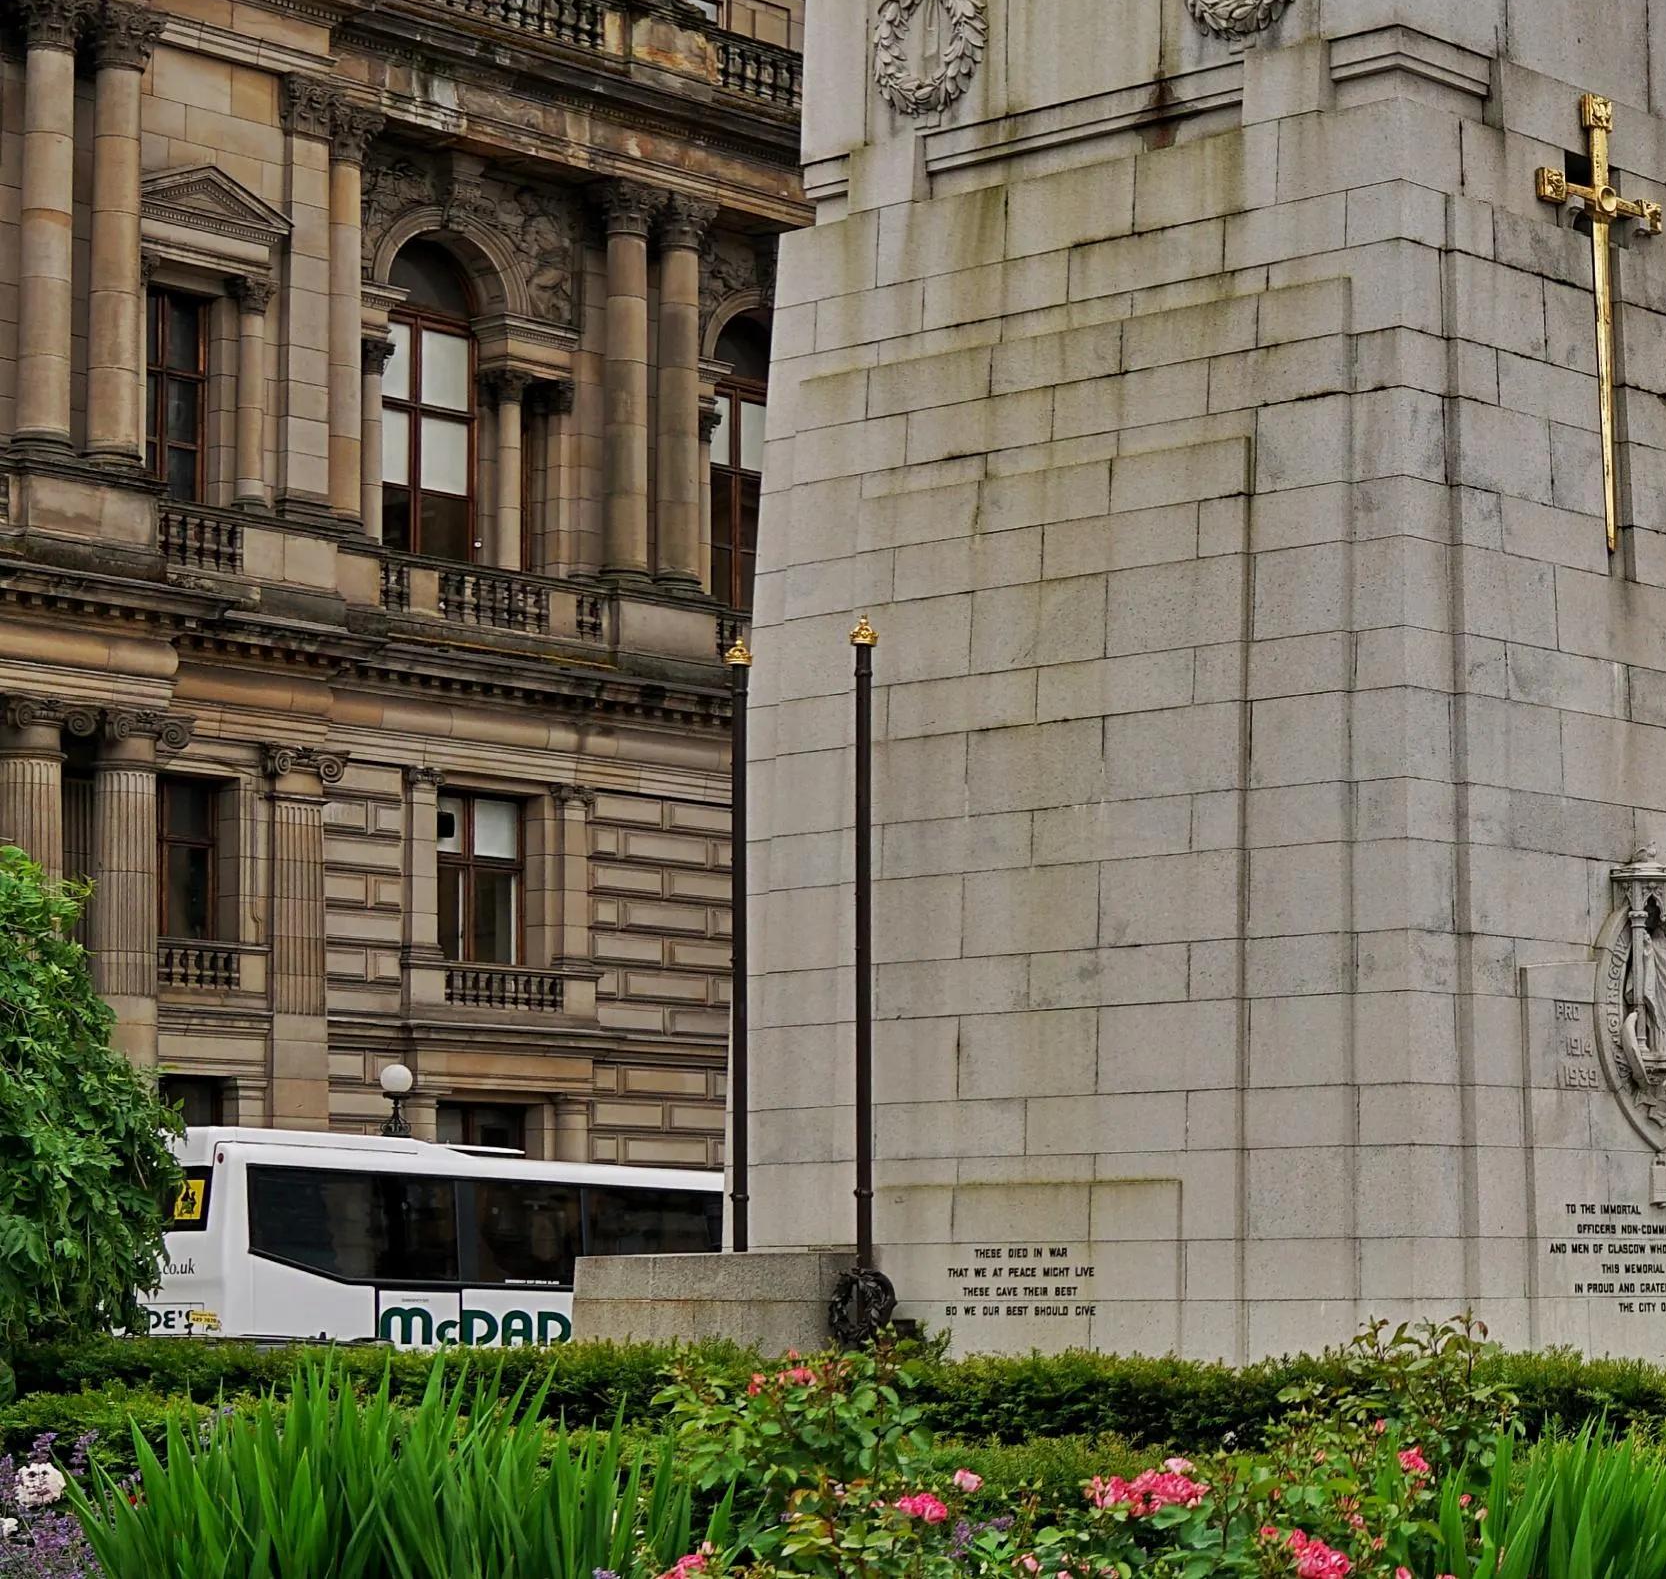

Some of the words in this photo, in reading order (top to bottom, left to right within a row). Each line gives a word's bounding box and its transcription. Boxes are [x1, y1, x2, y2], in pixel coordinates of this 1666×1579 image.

[1565, 1203, 1577, 1215] TO
[1580, 1203, 1596, 1215] THE
[1600, 1203, 1642, 1216] IMMORTAL
[1576, 1223, 1617, 1235] OFFICERS
[974, 1248, 1002, 1259] THESE
[1007, 1247, 1029, 1259] DIED
[1033, 1247, 1043, 1259] IN
[1048, 1247, 1068, 1258] WAR
[1549, 1243, 1567, 1255] AND
[1571, 1243, 1590, 1255] MEN
[1592, 1243, 1604, 1255] OF
[1607, 1243, 1647, 1255] GLASGOW
[947, 1267, 969, 1278] THAT
[973, 1267, 987, 1278] WE
[991, 1267, 1004, 1278] AT
[1007, 1266, 1037, 1278] PEACE
[1042, 1266, 1070, 1278] MIGHT
[1074, 1266, 1095, 1278] LIVE
[1601, 1263, 1620, 1274] THIS
[1624, 1263, 1665, 1275] MEMORIAL
[962, 1286, 990, 1297] THESE
[995, 1286, 1018, 1297] GAVE
[1022, 1286, 1049, 1297] THEIR
[1054, 1286, 1078, 1297] BEST
[1574, 1282, 1584, 1294] IN
[1586, 1282, 1615, 1294] PROUD
[1618, 1282, 1636, 1294] AND
[945, 1306, 958, 1317] SO
[963, 1306, 977, 1317] WE
[982, 1306, 1000, 1316] OUR
[1006, 1306, 1029, 1316] BEST
[1034, 1305, 1069, 1316] SHOULD
[1074, 1305, 1097, 1316] GIVE
[1618, 1302, 1635, 1313] THE
[1638, 1302, 1657, 1313] CITY
